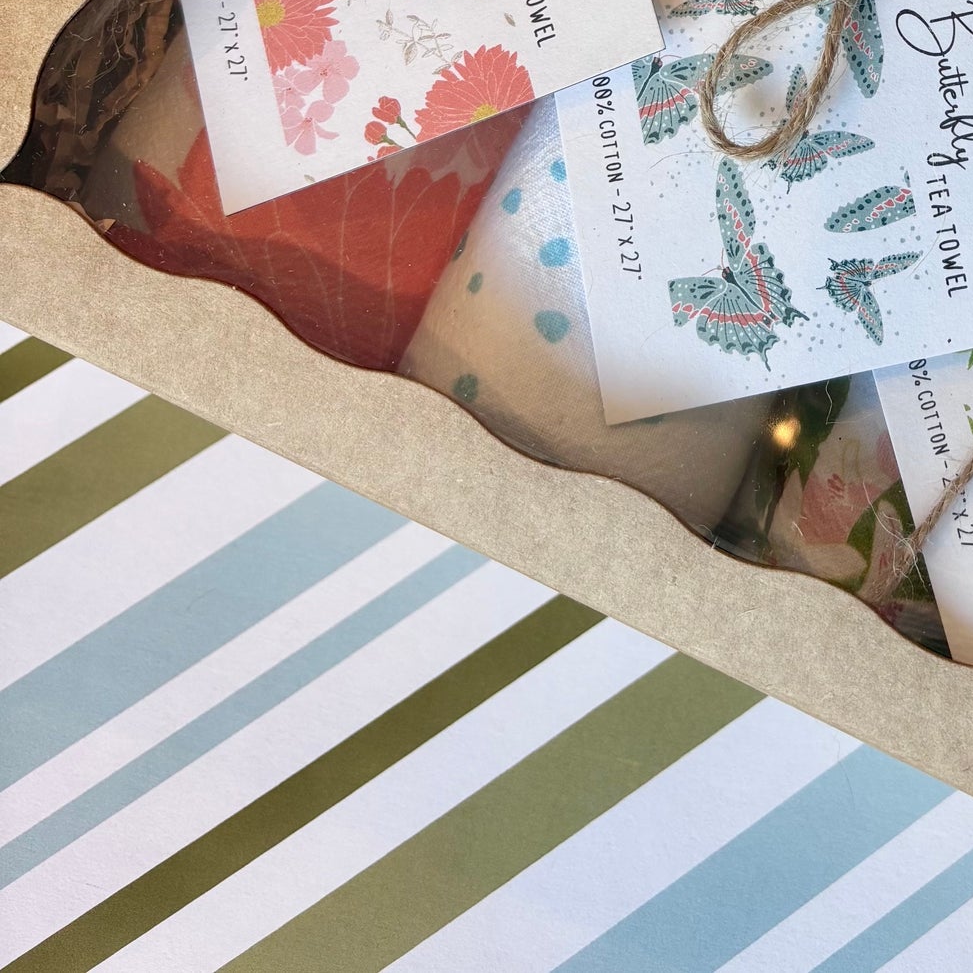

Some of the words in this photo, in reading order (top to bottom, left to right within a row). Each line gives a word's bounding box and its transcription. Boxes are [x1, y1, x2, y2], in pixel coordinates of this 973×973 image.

[592, 76, 615, 116] 00%
[599, 120, 624, 183] COTTON
[926, 174, 953, 218] TEA
[936, 224, 969, 298] TOWEL
[908, 358, 932, 387] 0%
[917, 390, 950, 457] COTTON
